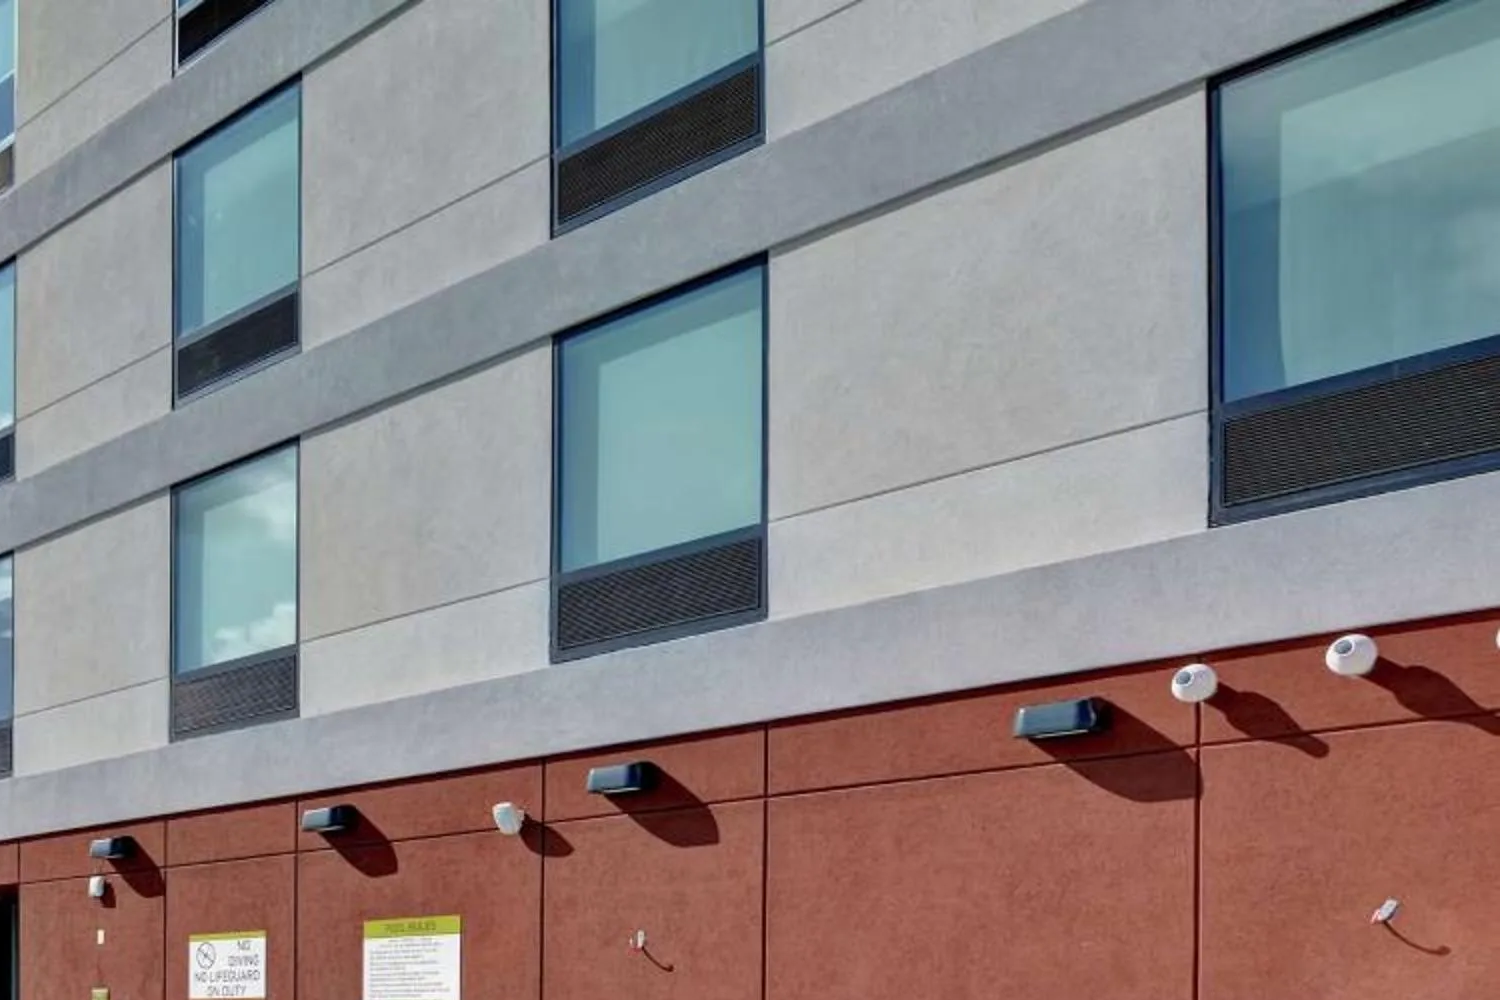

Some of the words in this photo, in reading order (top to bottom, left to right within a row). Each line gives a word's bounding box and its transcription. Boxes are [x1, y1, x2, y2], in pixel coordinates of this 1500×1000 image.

[237, 940, 252, 951] NO
[227, 953, 261, 967] DIVING
[195, 971, 207, 983] NO
[209, 968, 261, 983] LIFEGUARD
[222, 984, 247, 997] DUTY
